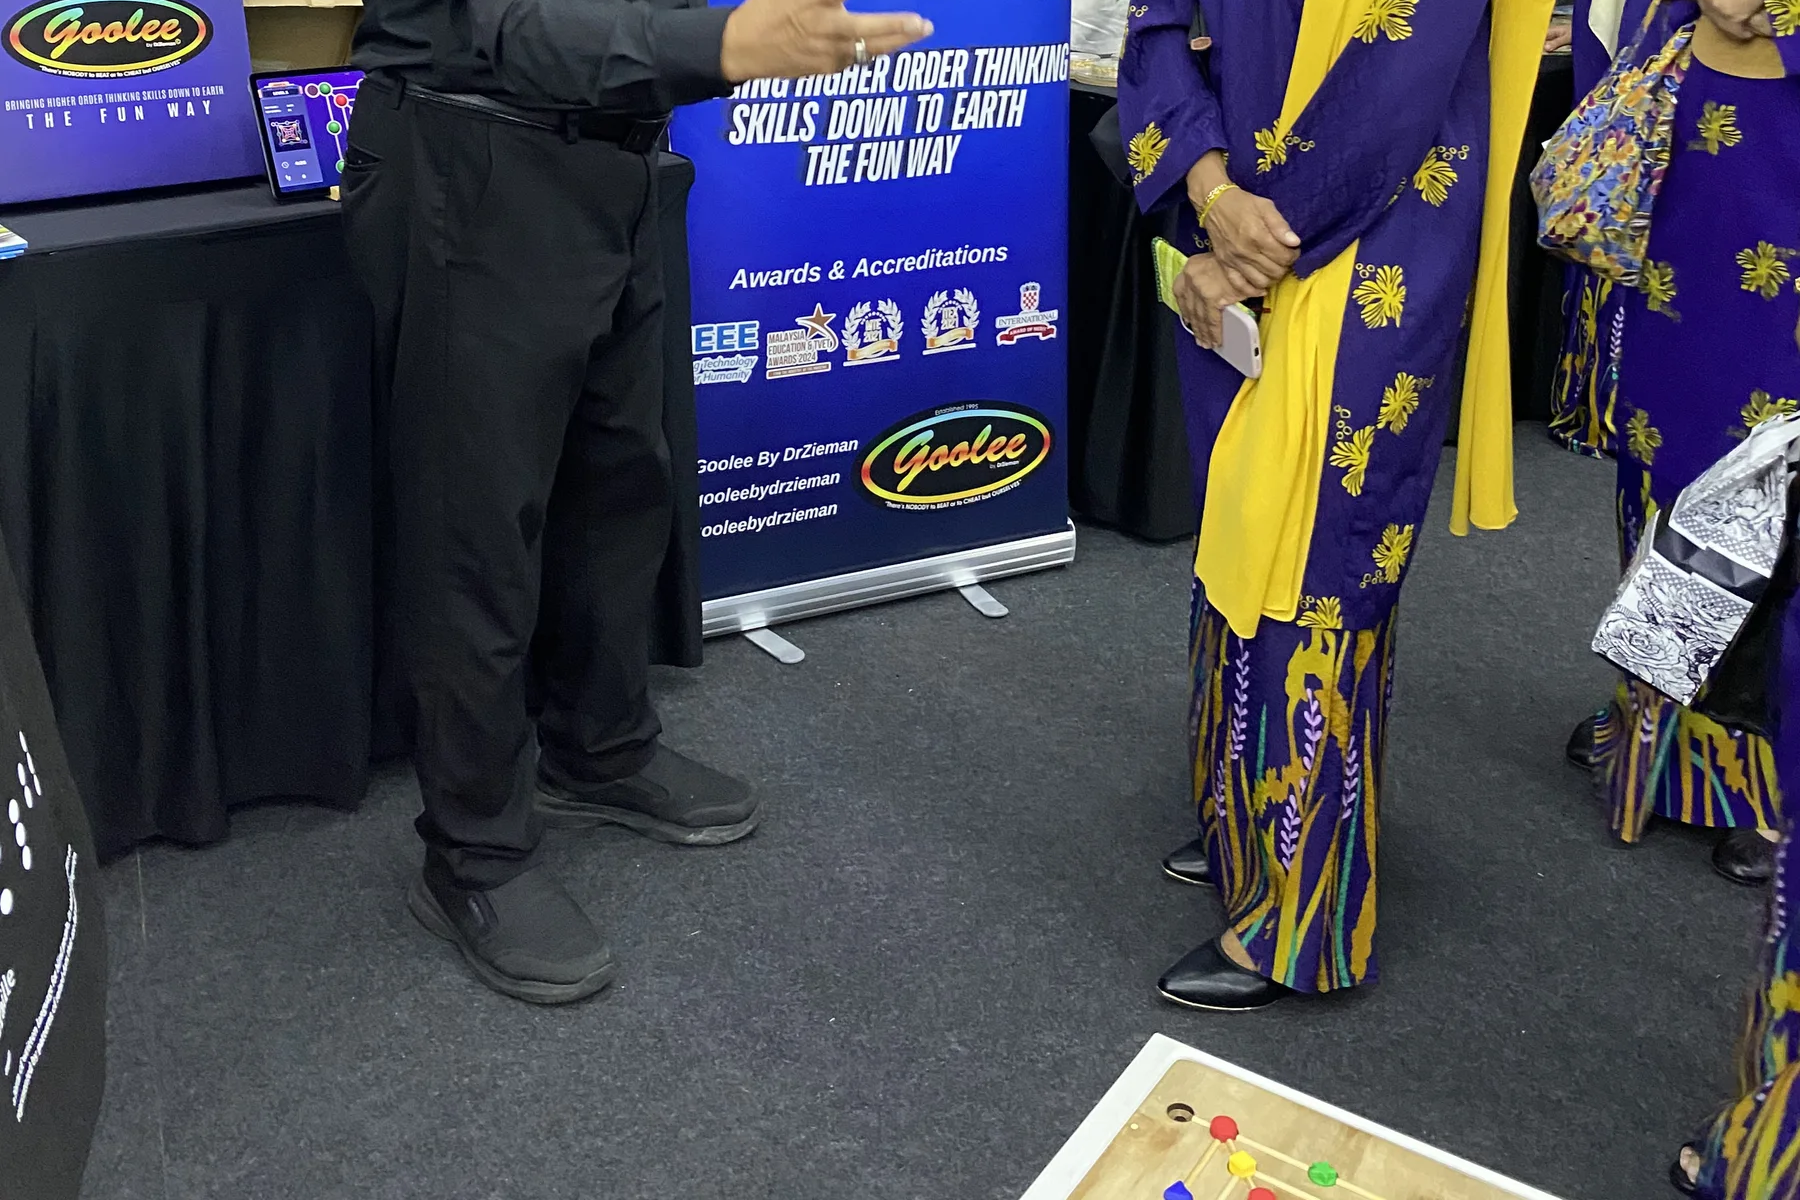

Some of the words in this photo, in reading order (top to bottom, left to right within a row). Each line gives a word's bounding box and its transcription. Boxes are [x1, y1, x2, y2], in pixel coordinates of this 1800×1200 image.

[43, 7, 182, 60] Goolee
[892, 49, 968, 92] ORDER
[972, 43, 1070, 86] THINKING
[5, 98, 45, 112] BRINGING
[47, 95, 76, 108] HIGHER
[78, 94, 104, 106] ORDER
[105, 91, 141, 104] THINKING
[142, 89, 166, 101] SKILLS
[168, 87, 190, 99] DOWN
[192, 86, 200, 97] TO
[202, 85, 225, 97] EARTH
[26, 111, 72, 129] THE
[100, 105, 145, 124] FUN
[167, 100, 211, 118] WAY
[728, 101, 819, 145] SKILLS
[827, 96, 908, 140] DOWN
[915, 93, 948, 133] TO
[951, 89, 1028, 131] EARTH
[804, 144, 853, 187] THE
[853, 138, 907, 183] FUN
[906, 135, 963, 178] WAY
[729, 263, 821, 290] Awards
[827, 260, 845, 280] &
[851, 243, 1008, 279] Accreditations
[998, 312, 1056, 326] INTERNATIONAL
[768, 331, 805, 344] MALAYSIA
[768, 343, 806, 355] EDUCATION
[814, 339, 831, 349] TVET
[702, 355, 757, 369] Technology
[768, 355, 798, 367] AWARDS
[799, 352, 816, 364] 2024
[703, 369, 750, 383] Humanity
[757, 451, 780, 468] By
[783, 439, 858, 462] DrZieman
[893, 424, 1028, 492] Goolee
[700, 503, 838, 538] ooleebydrzieman
